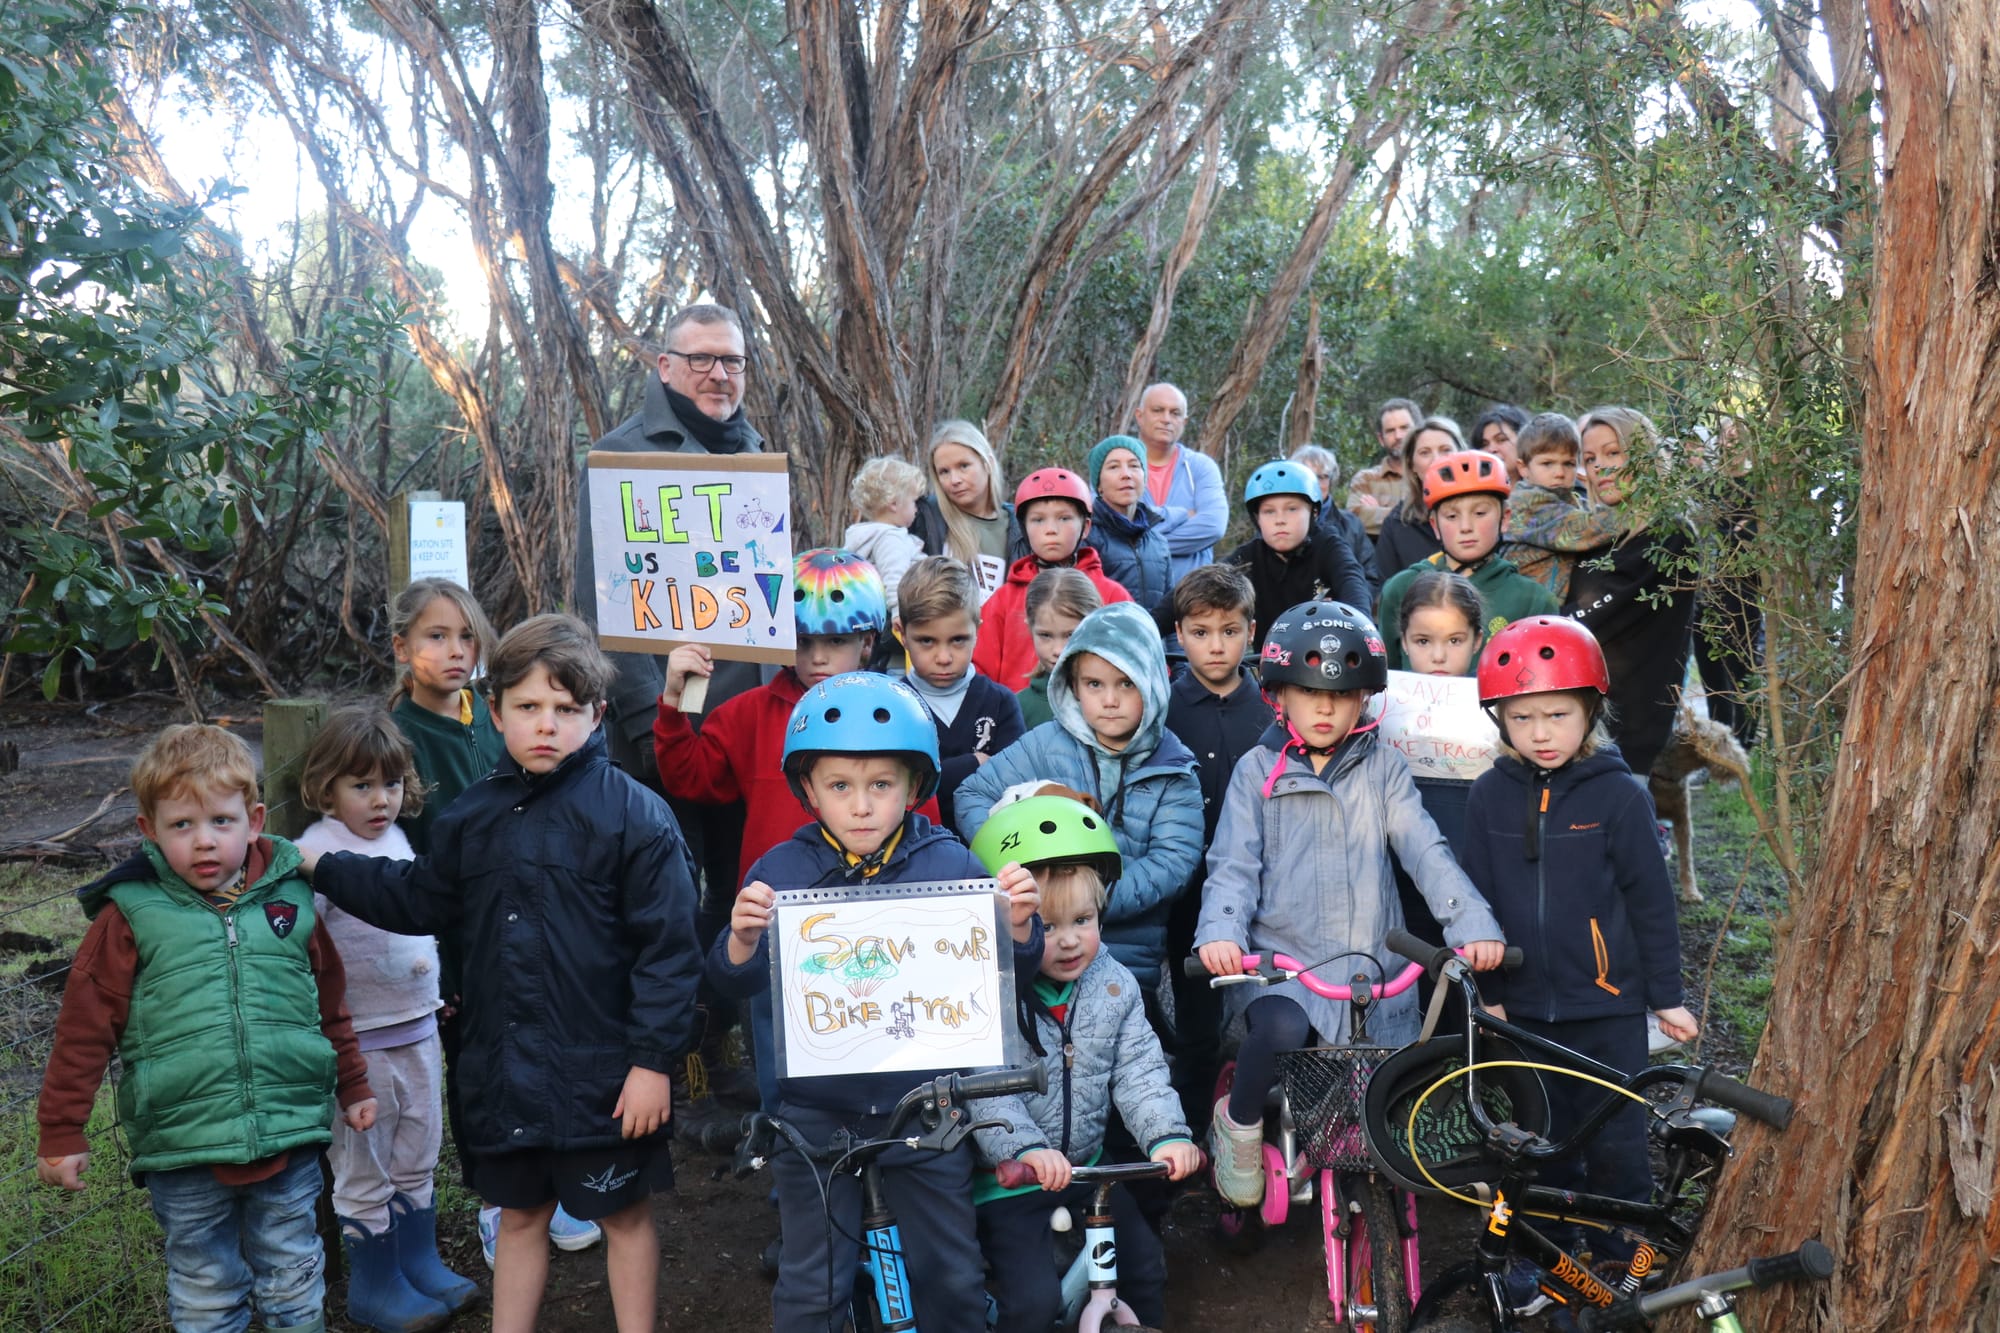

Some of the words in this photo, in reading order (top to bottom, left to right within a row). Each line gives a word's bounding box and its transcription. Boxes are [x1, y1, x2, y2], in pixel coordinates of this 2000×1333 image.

[620, 481, 732, 543] LET
[695, 551, 740, 577] BE
[1396, 678, 1458, 707] SAVE
[1431, 741, 1494, 760] TRACK
[1000, 832, 1021, 853] S1
[801, 912, 915, 969] Save
